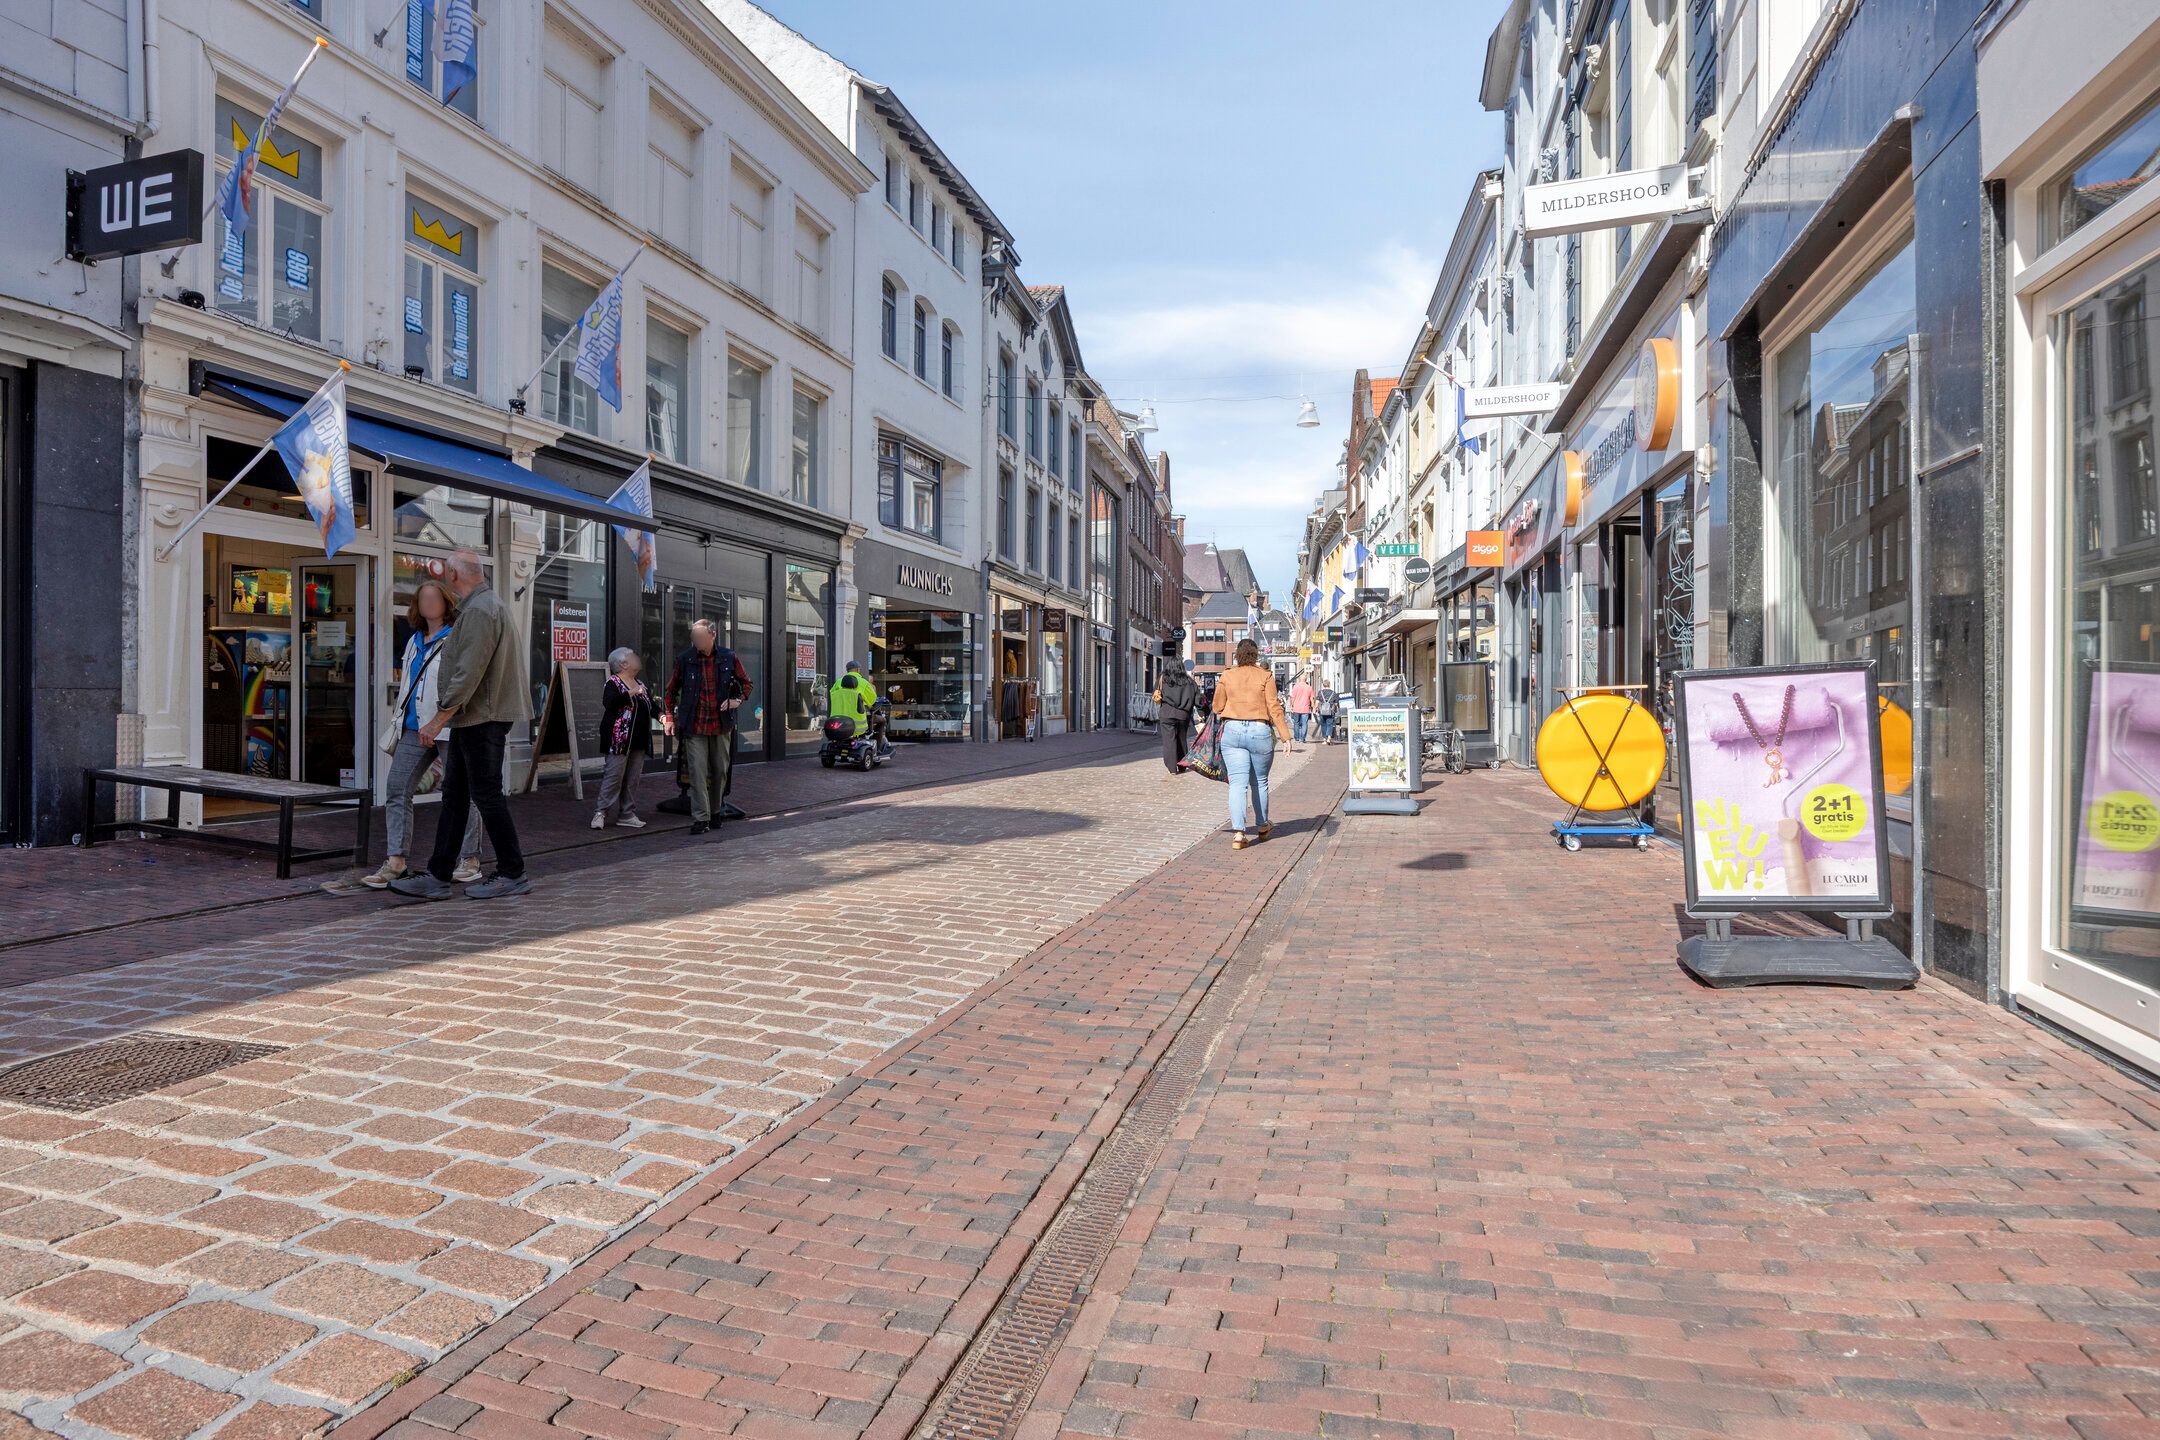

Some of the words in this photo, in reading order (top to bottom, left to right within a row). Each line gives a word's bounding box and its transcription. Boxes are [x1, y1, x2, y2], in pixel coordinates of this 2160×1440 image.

[101, 172, 172, 233] WE
[1541, 182, 1671, 213] MILDERSHOOF
[287, 248, 309, 291] 1966
[220, 275, 244, 302] De
[405, 296, 423, 335] 1966
[452, 291, 468, 359] Automatiek
[1474, 392, 1550, 407] MILDERSHOOF
[1380, 544, 1415, 555] VEITH
[1471, 543, 1499, 555] ziggo
[899, 564, 953, 596] MUNNICHS
[566, 630, 587, 643] KOOP
[554, 646, 564, 659] TE
[566, 647, 587, 660] HUUR
[1353, 714, 1401, 722] Mildershoof
[1191, 758, 1222, 776] ZEEMAN
[1813, 795, 1852, 812] 2+1
[1813, 811, 1854, 825] gratis
[1822, 875, 1868, 884] LUCARDI
